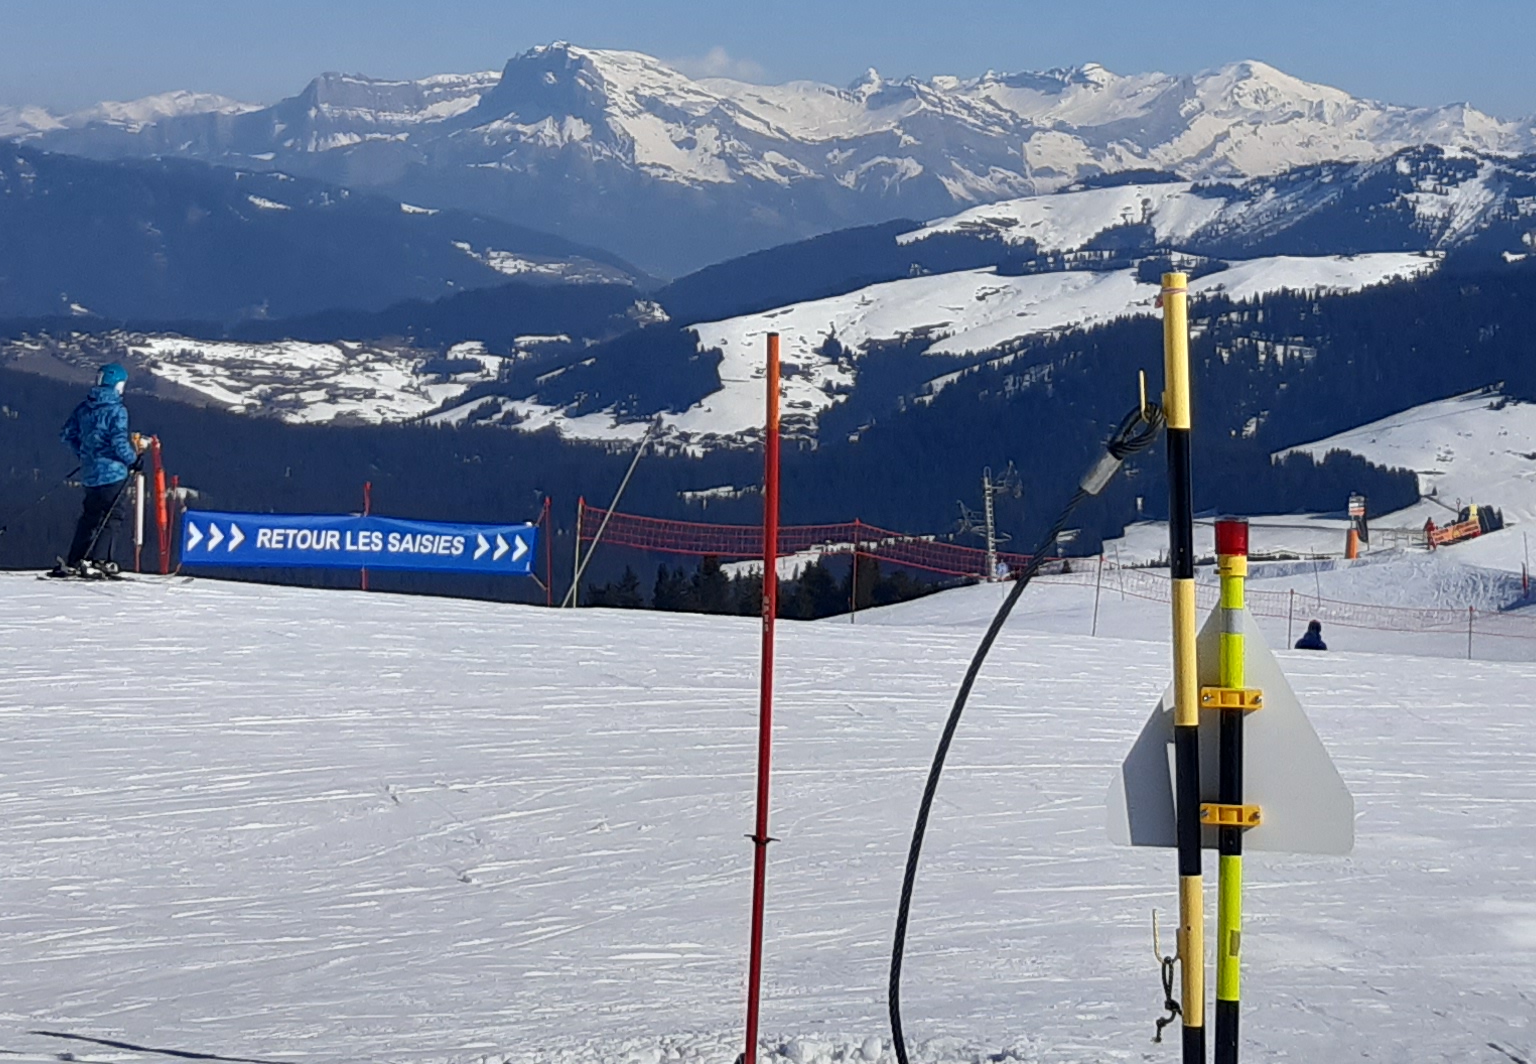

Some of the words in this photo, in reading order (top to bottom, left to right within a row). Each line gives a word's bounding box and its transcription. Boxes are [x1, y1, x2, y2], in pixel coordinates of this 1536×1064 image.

[256, 528, 340, 551] RETOUR
[345, 530, 384, 552] LES
[387, 532, 465, 555] SAISIES
